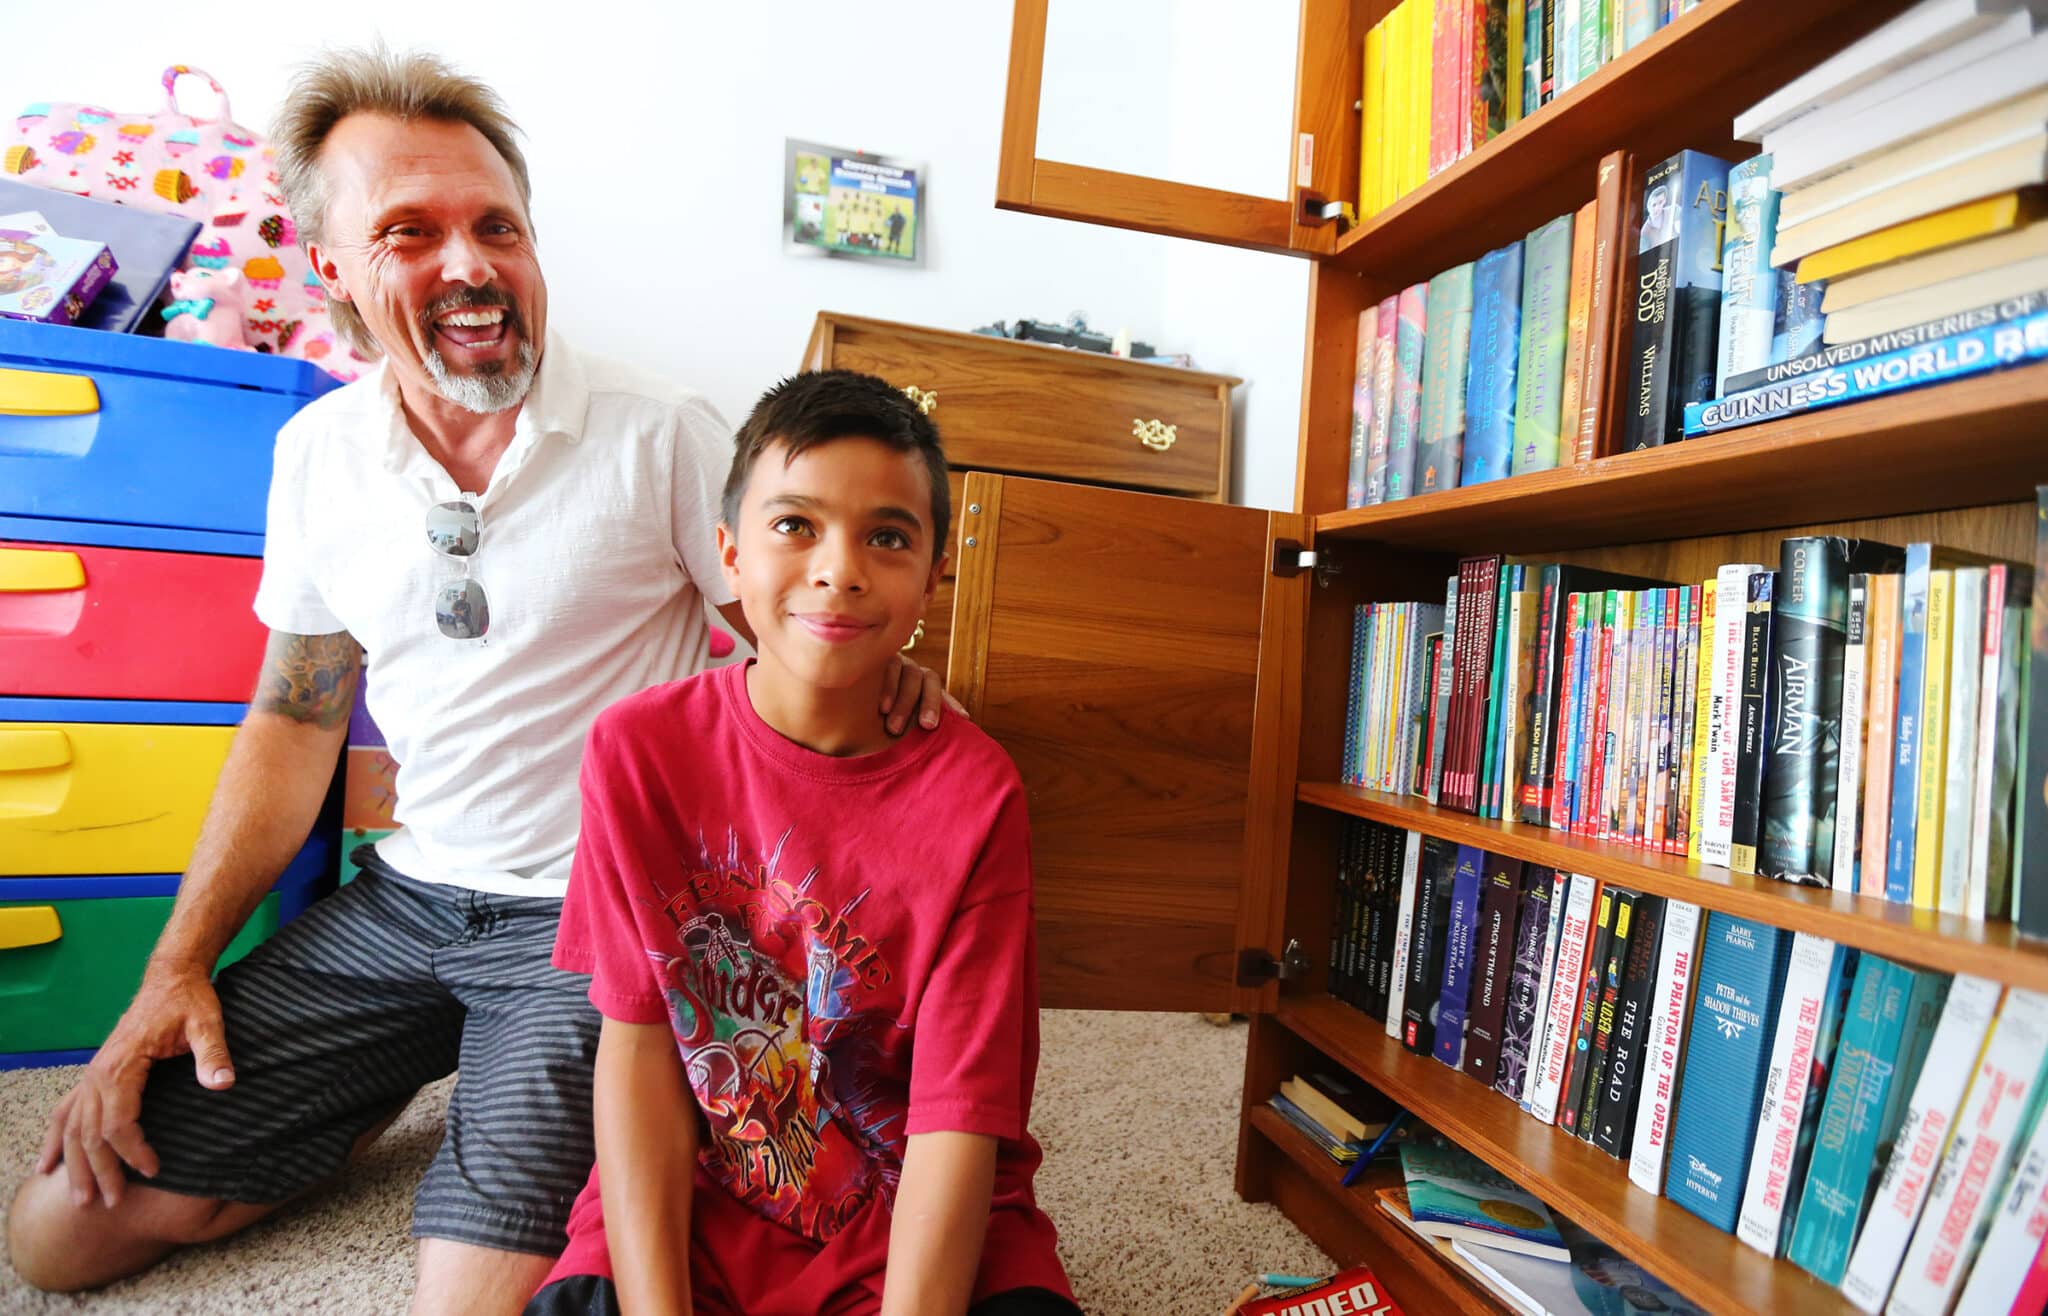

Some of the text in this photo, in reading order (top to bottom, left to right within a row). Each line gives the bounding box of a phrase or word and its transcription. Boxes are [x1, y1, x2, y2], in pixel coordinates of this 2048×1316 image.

[1637, 272, 1657, 322] DOD
[1652, 258, 1668, 323] ADVENTURES
[1766, 293, 2033, 382] UNSOLVED MYSTERIES OF
[1638, 345, 1656, 417] WILLIAMS
[1854, 338, 1985, 390] WORLD
[1792, 548, 1806, 603] COLFER
[1440, 591, 1457, 696] JUST FOR FUN
[1728, 621, 1741, 644] THE
[1750, 626, 1761, 688] BLACK BEAUTY
[1710, 696, 1722, 753] Mark Twain
[1776, 655, 1808, 757] AIRMAN
[1530, 712, 1542, 775] WILSON RAWLS
[1722, 731, 1737, 746] OF
[1899, 715, 1912, 765] Moby Dick
[1721, 752, 1734, 775] TOM
[1719, 780, 1732, 827] SAWYER
[1390, 835, 1400, 884] HADDIX
[1421, 879, 1432, 918] REVENGE
[1417, 932, 1427, 950] THE
[1447, 900, 1464, 987] THE SOUL STEALER
[1458, 925, 1468, 957] NIGHT
[1490, 910, 1501, 945] ATTACK
[1527, 926, 1538, 958] CURSE
[1368, 959, 1378, 986] ENEMY
[1379, 961, 1388, 995] BARONS
[1414, 952, 1425, 982] WITCH
[1486, 958, 1496, 978] THE
[1521, 973, 1533, 994] THE
[1550, 914, 1574, 1019] AND RIP VAN WINKLE
[1673, 951, 1688, 977] THE
[1482, 978, 1493, 1006] FIEND
[1518, 995, 1529, 1024] BANE
[1547, 919, 1586, 1084] THE LEGEND OF SLEEPY HOLLOW
[1704, 996, 1759, 1027] SHADOW THIEVES
[1716, 983, 1736, 1001] PETER
[1799, 997, 1819, 1023] THE
[1598, 1002, 1615, 1034] LOSER
[1663, 981, 1684, 1047] PHANTOM
[1609, 1000, 1638, 1103] THE ROAD
[1661, 1051, 1674, 1068] OF
[1785, 1026, 1816, 1103] HUNCHBACK
[1656, 1075, 1670, 1100] THE
[1820, 1042, 1870, 1152] STARCATCHERS
[1649, 1104, 1666, 1146] OPERA
[1781, 1106, 1799, 1124] OF
[1771, 1126, 1795, 1168] NOTRE
[1892, 1108, 1946, 1219] OLIVER TWIST
[1688, 1154, 1722, 1184] Disney
[1686, 1178, 1718, 1202] HYPERION
[1763, 1171, 1785, 1210] DAME
[1937, 1134, 2001, 1247] HUCKLEBERRY
[1262, 1281, 1379, 1316] DEO
